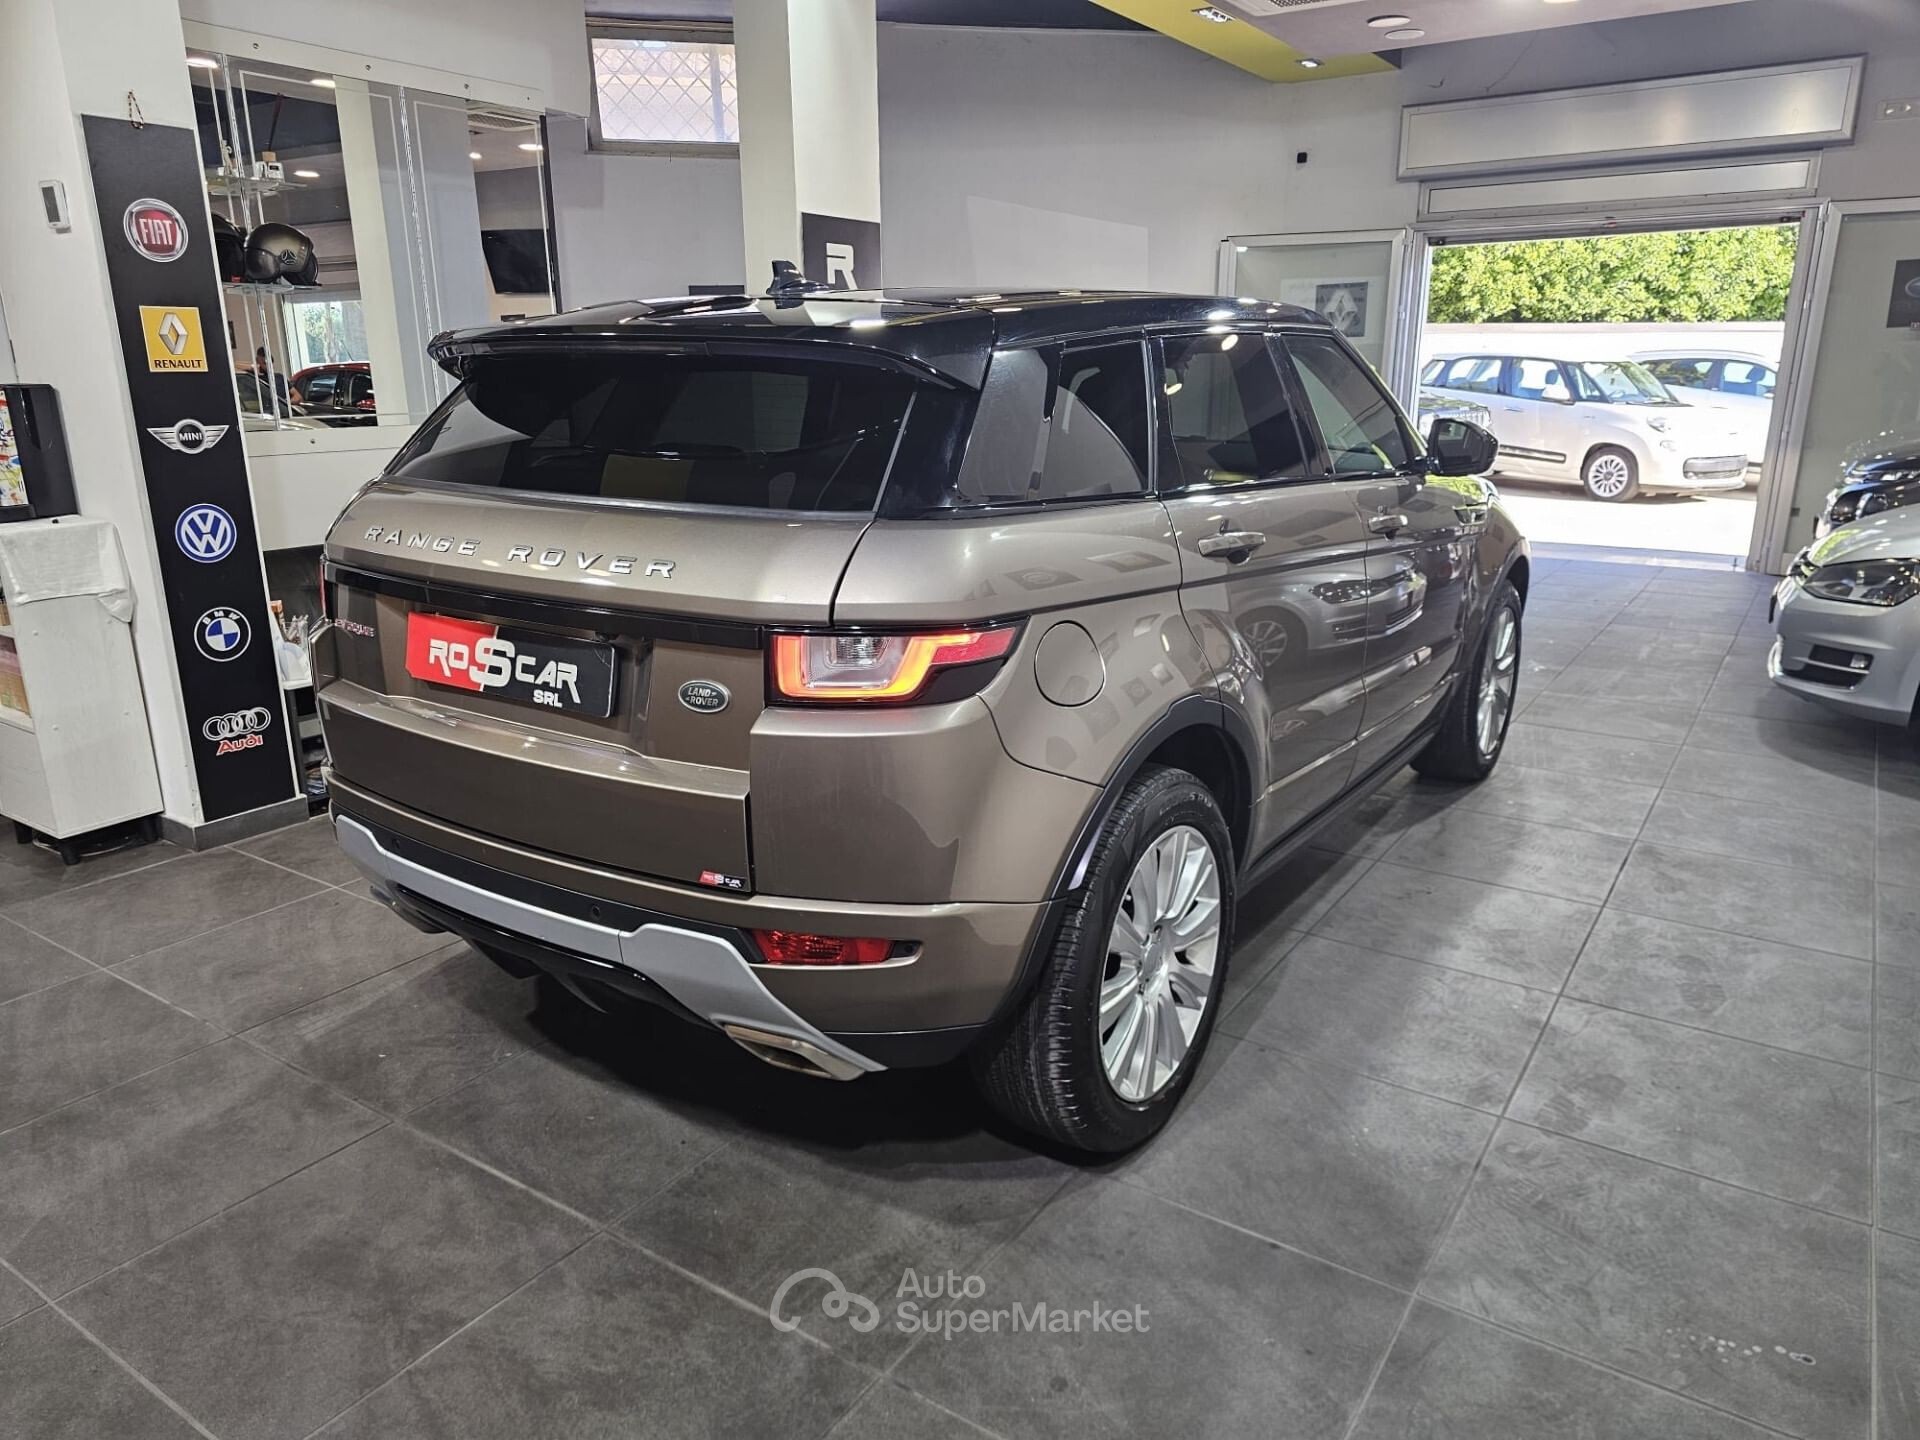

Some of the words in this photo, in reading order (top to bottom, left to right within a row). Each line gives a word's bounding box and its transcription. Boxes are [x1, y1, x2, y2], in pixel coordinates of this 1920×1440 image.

[138, 217, 173, 247] FIAT
[826, 242, 858, 290] R
[153, 358, 203, 370] RENAULT
[178, 431, 203, 442] MINI
[363, 524, 481, 557] RANGE
[507, 543, 677, 580] ROVER
[202, 610, 240, 625] BMW
[532, 689, 563, 708] SRL
[687, 686, 712, 698] LAND
[689, 695, 719, 707] ROVER
[215, 733, 264, 757] Audi
